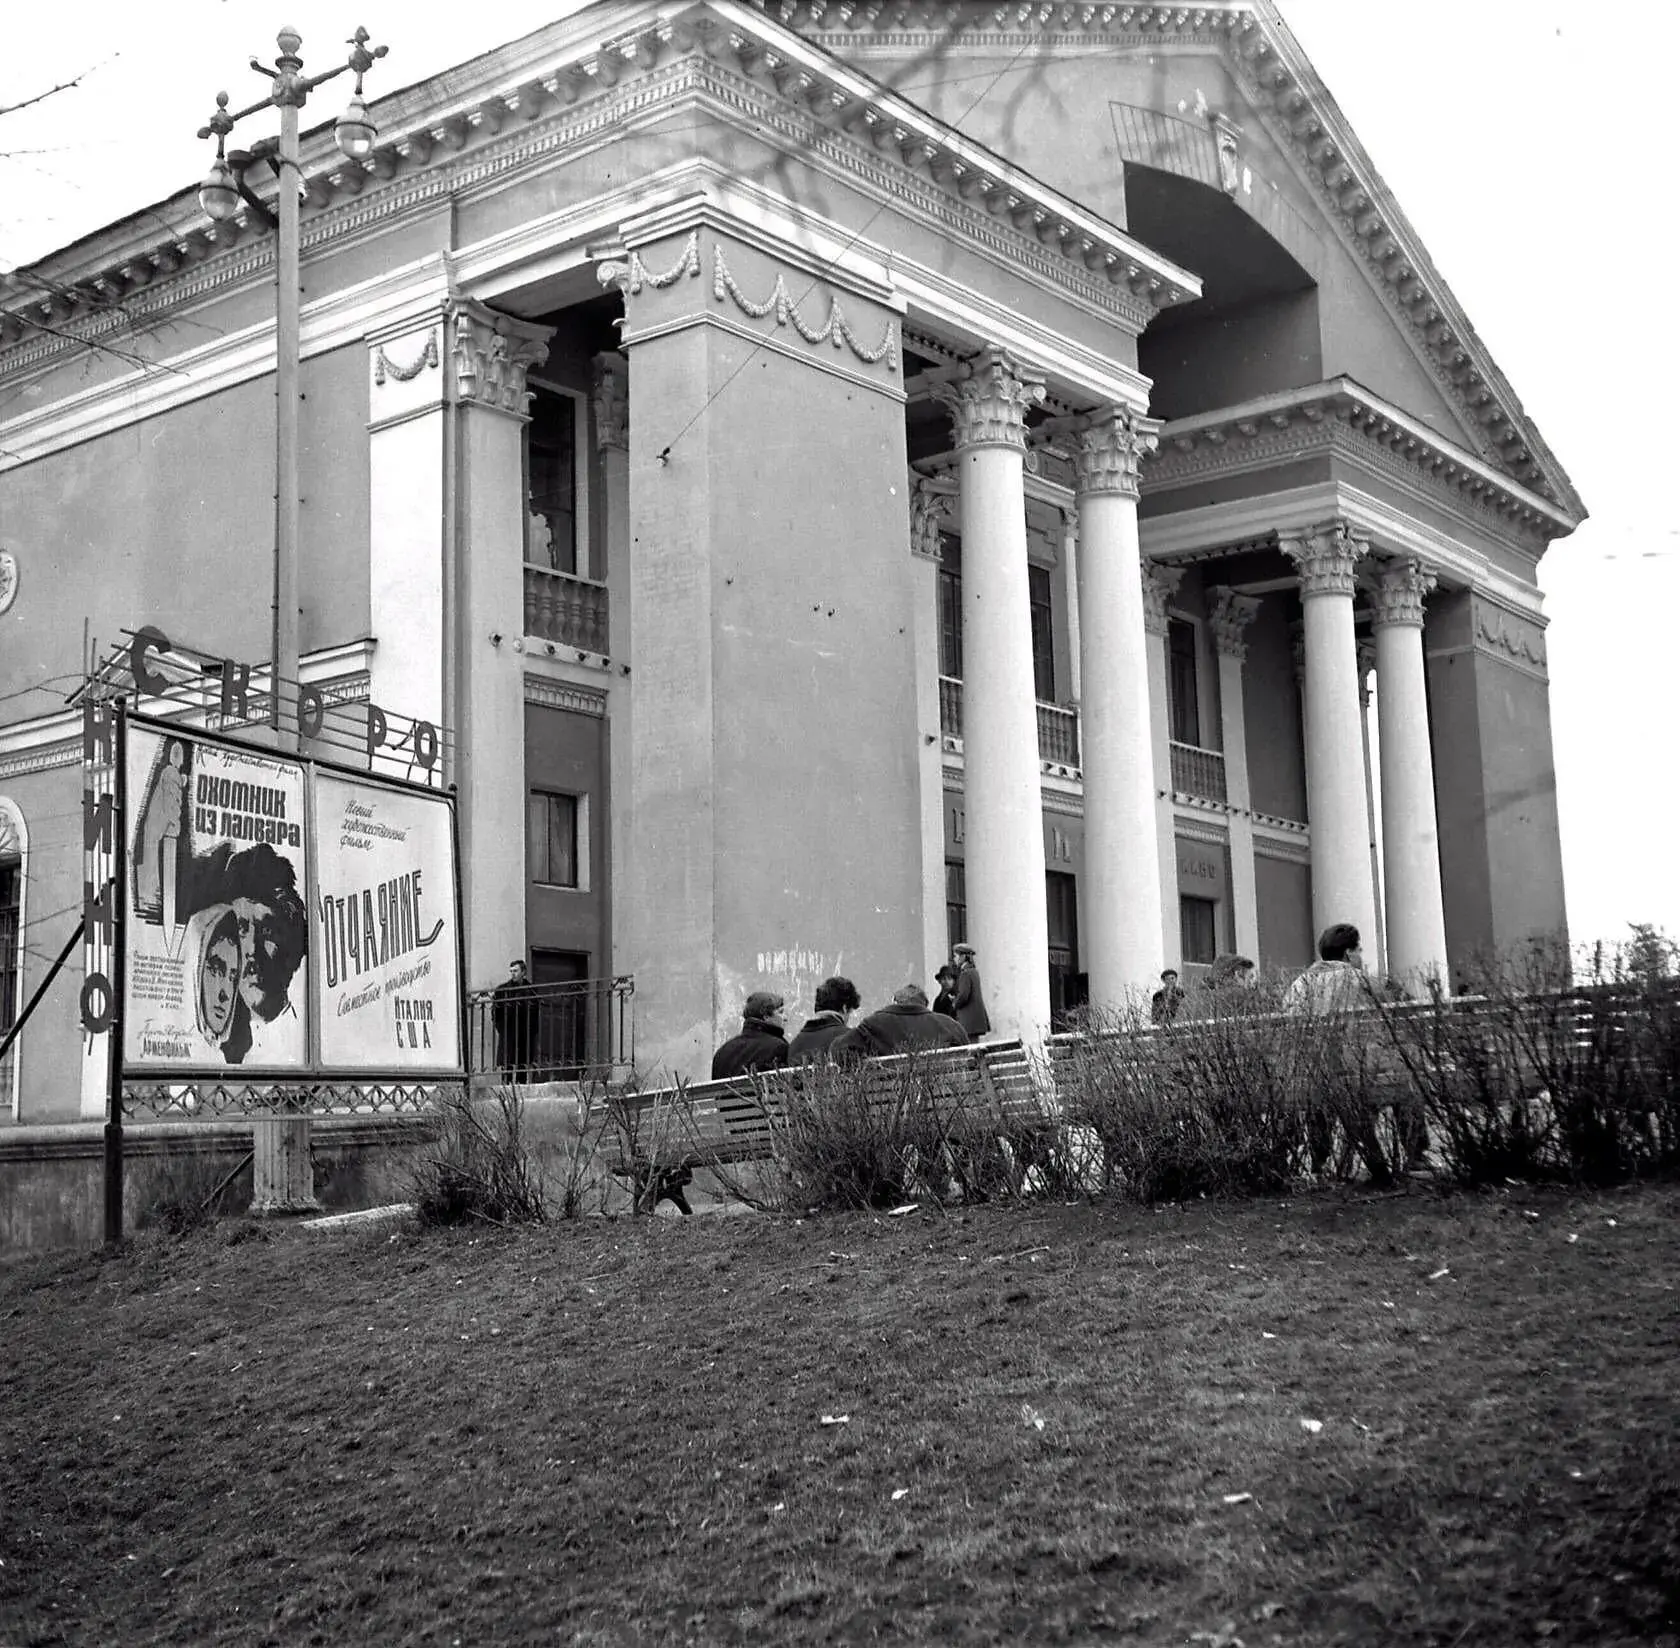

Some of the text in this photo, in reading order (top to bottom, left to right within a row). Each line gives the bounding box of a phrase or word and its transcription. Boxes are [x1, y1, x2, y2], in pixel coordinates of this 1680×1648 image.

[131, 625, 437, 769] СКОРО
[79, 699, 114, 1034] КИНО
[324, 870, 444, 988] ОТЧАЯНИЕ
[395, 1021, 432, 1049] США
